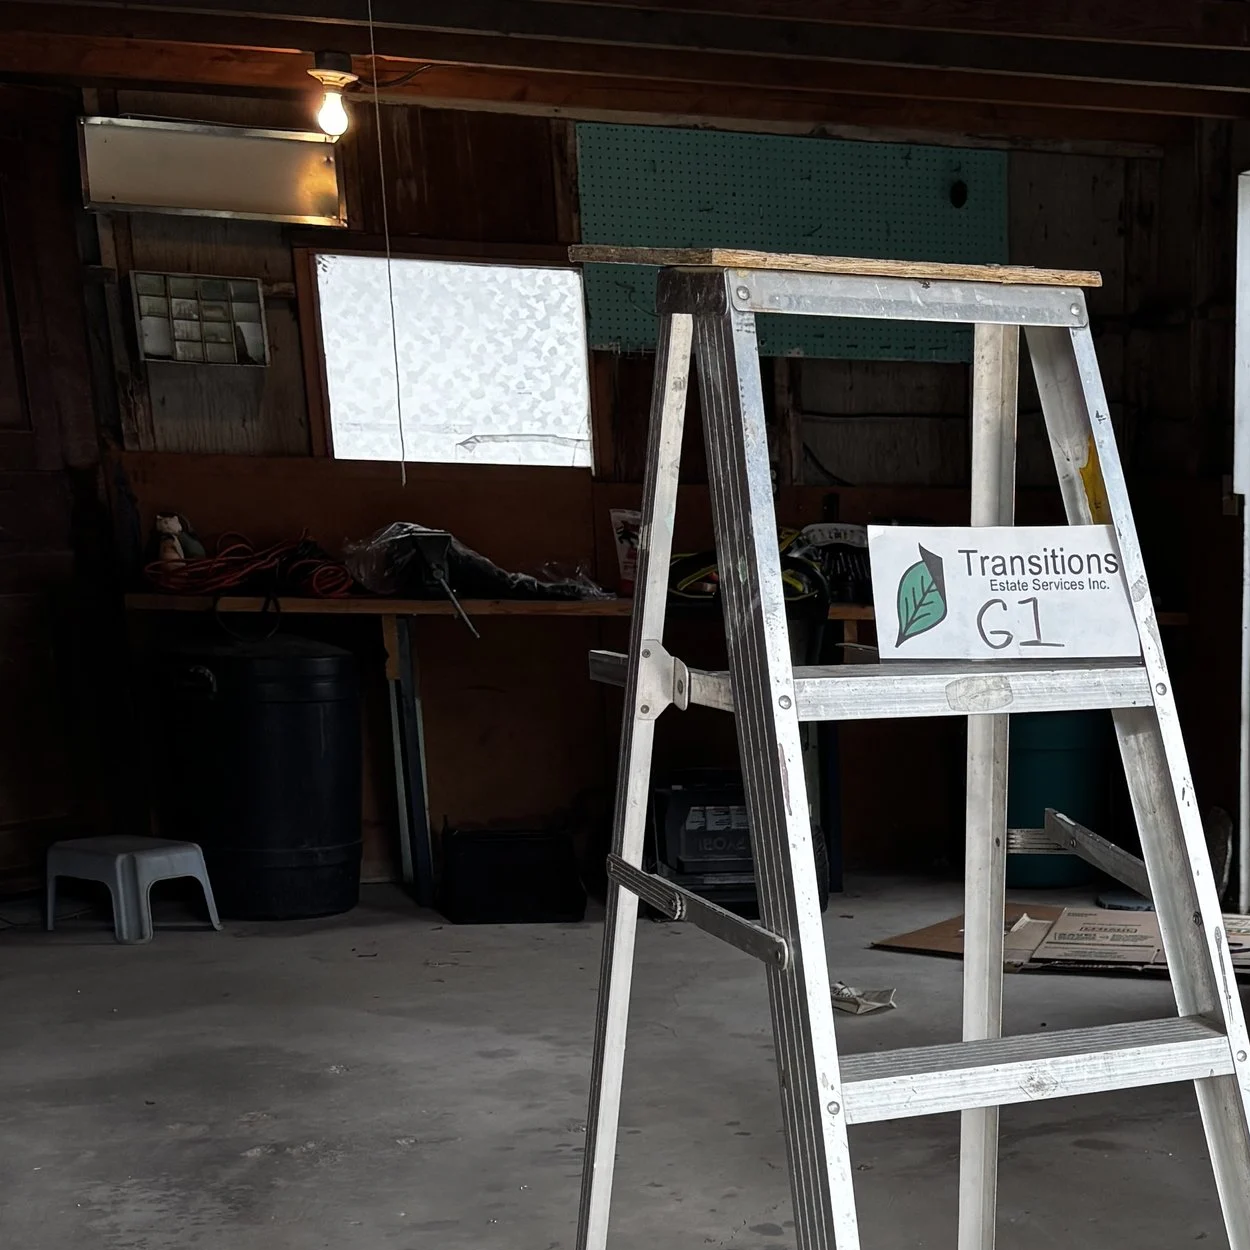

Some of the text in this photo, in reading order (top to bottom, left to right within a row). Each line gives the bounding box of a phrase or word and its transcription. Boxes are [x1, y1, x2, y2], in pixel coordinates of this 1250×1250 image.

[957, 547, 1119, 576] Transitions
[990, 577, 1110, 591] Estate Services Inc.
[976, 597, 1065, 650] G1
